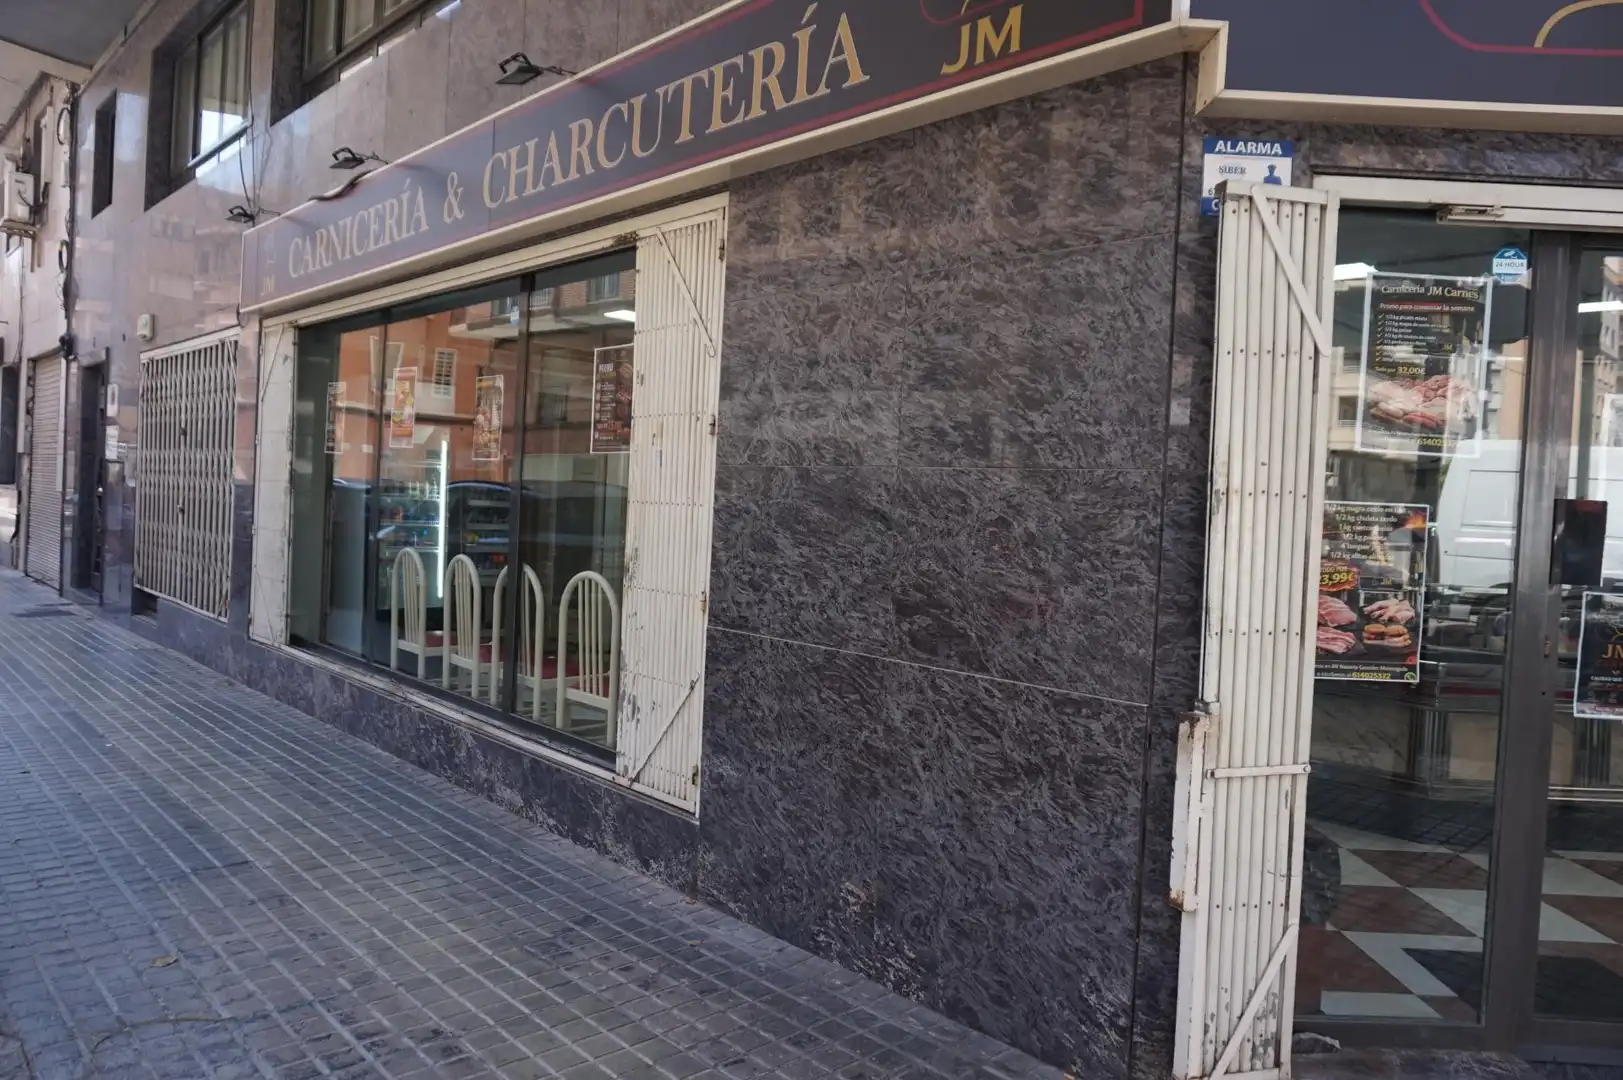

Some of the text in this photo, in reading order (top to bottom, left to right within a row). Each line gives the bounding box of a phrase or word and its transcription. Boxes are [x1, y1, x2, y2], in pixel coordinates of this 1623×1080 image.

[940, 4, 1024, 75] JM
[288, 2, 871, 279] CARNICERÍA & CHARCUTERÍA
[1214, 139, 1282, 155] ALARMA
[1218, 165, 1247, 175] SIBER
[260, 274, 275, 296] JM
[1381, 284, 1479, 299] Carnicería JM Carnes
[1380, 302, 1399, 310] Promo
[1397, 366, 1426, 375] 32,00€
[1326, 503, 1337, 511] 1/2
